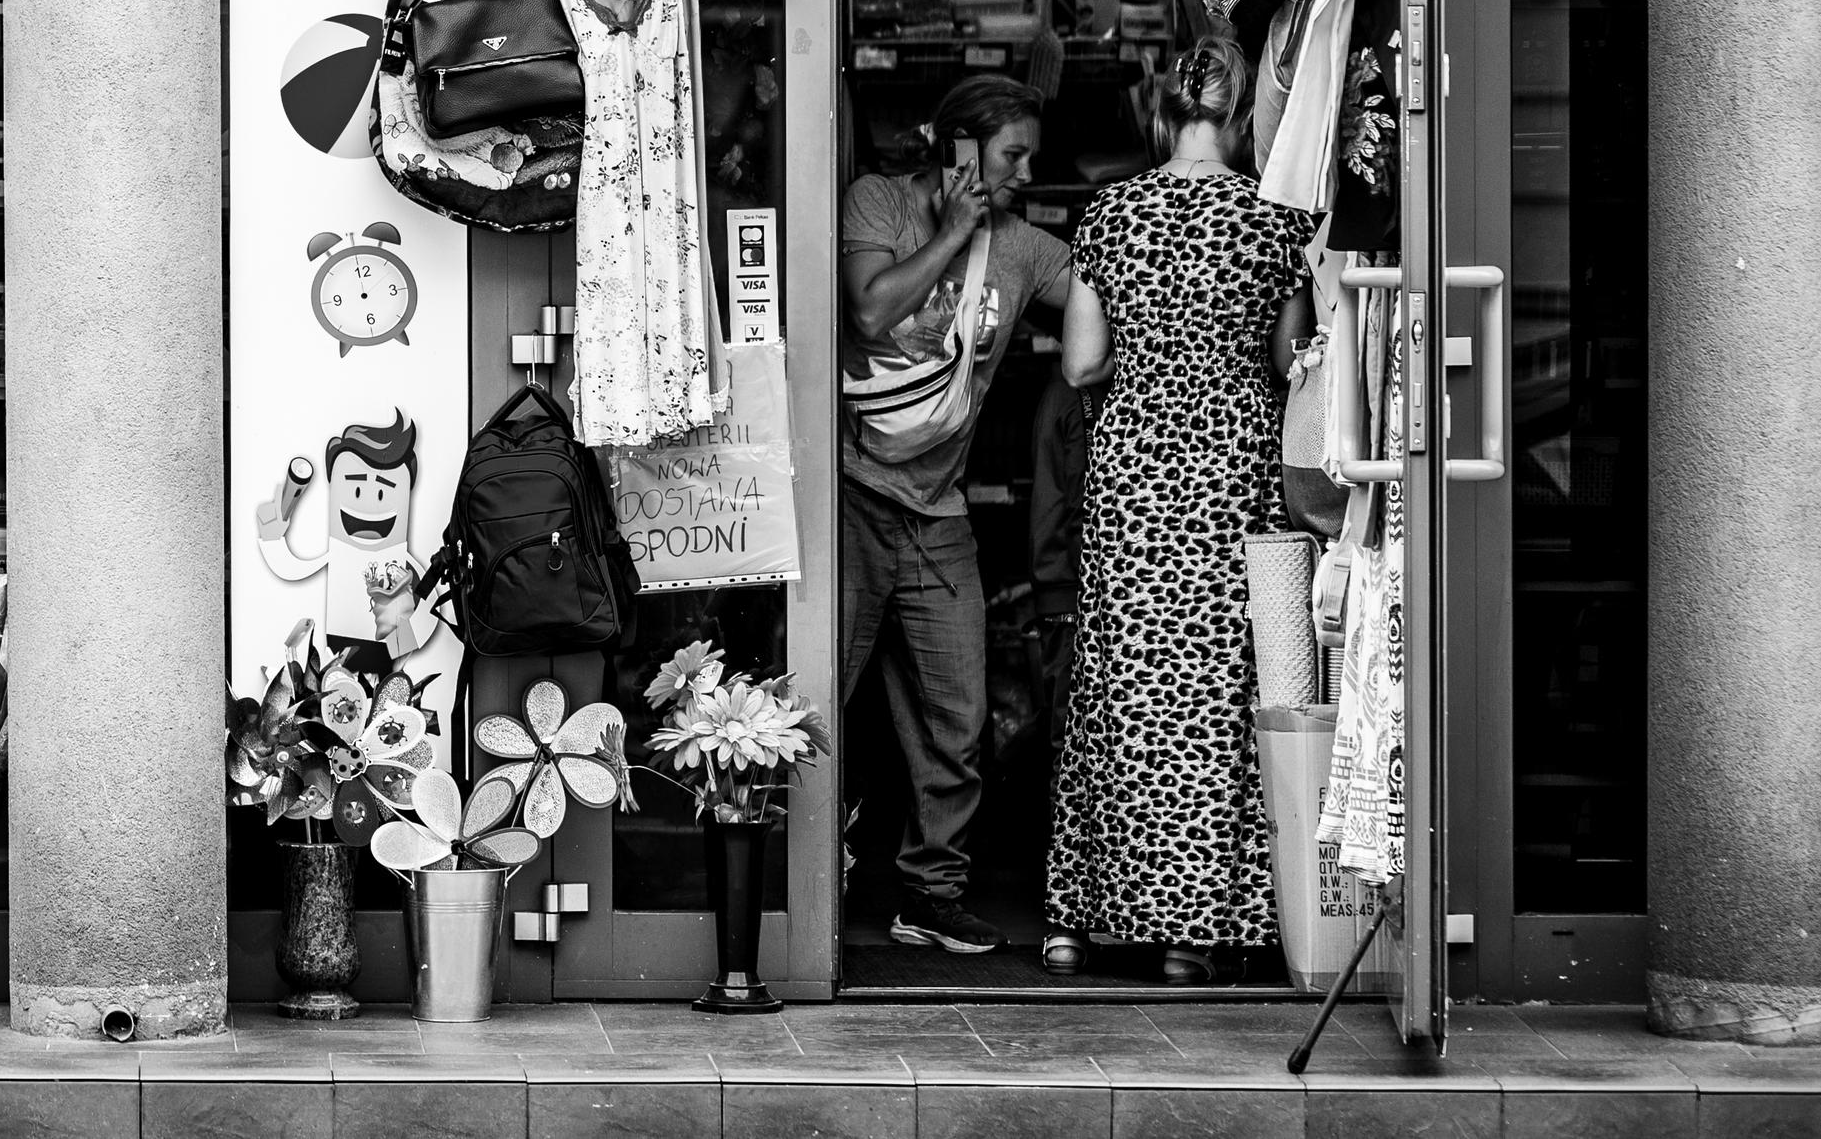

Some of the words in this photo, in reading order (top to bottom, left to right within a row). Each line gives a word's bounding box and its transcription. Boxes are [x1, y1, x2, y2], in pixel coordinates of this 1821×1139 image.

[355, 266, 371, 278] 12
[741, 280, 767, 290] VISA
[333, 295, 342, 306] 9
[389, 285, 398, 296] 3
[742, 304, 766, 314] VISA
[366, 314, 375, 325] 6
[658, 454, 721, 480] NOWA
[617, 476, 765, 524] DOSTAWA
